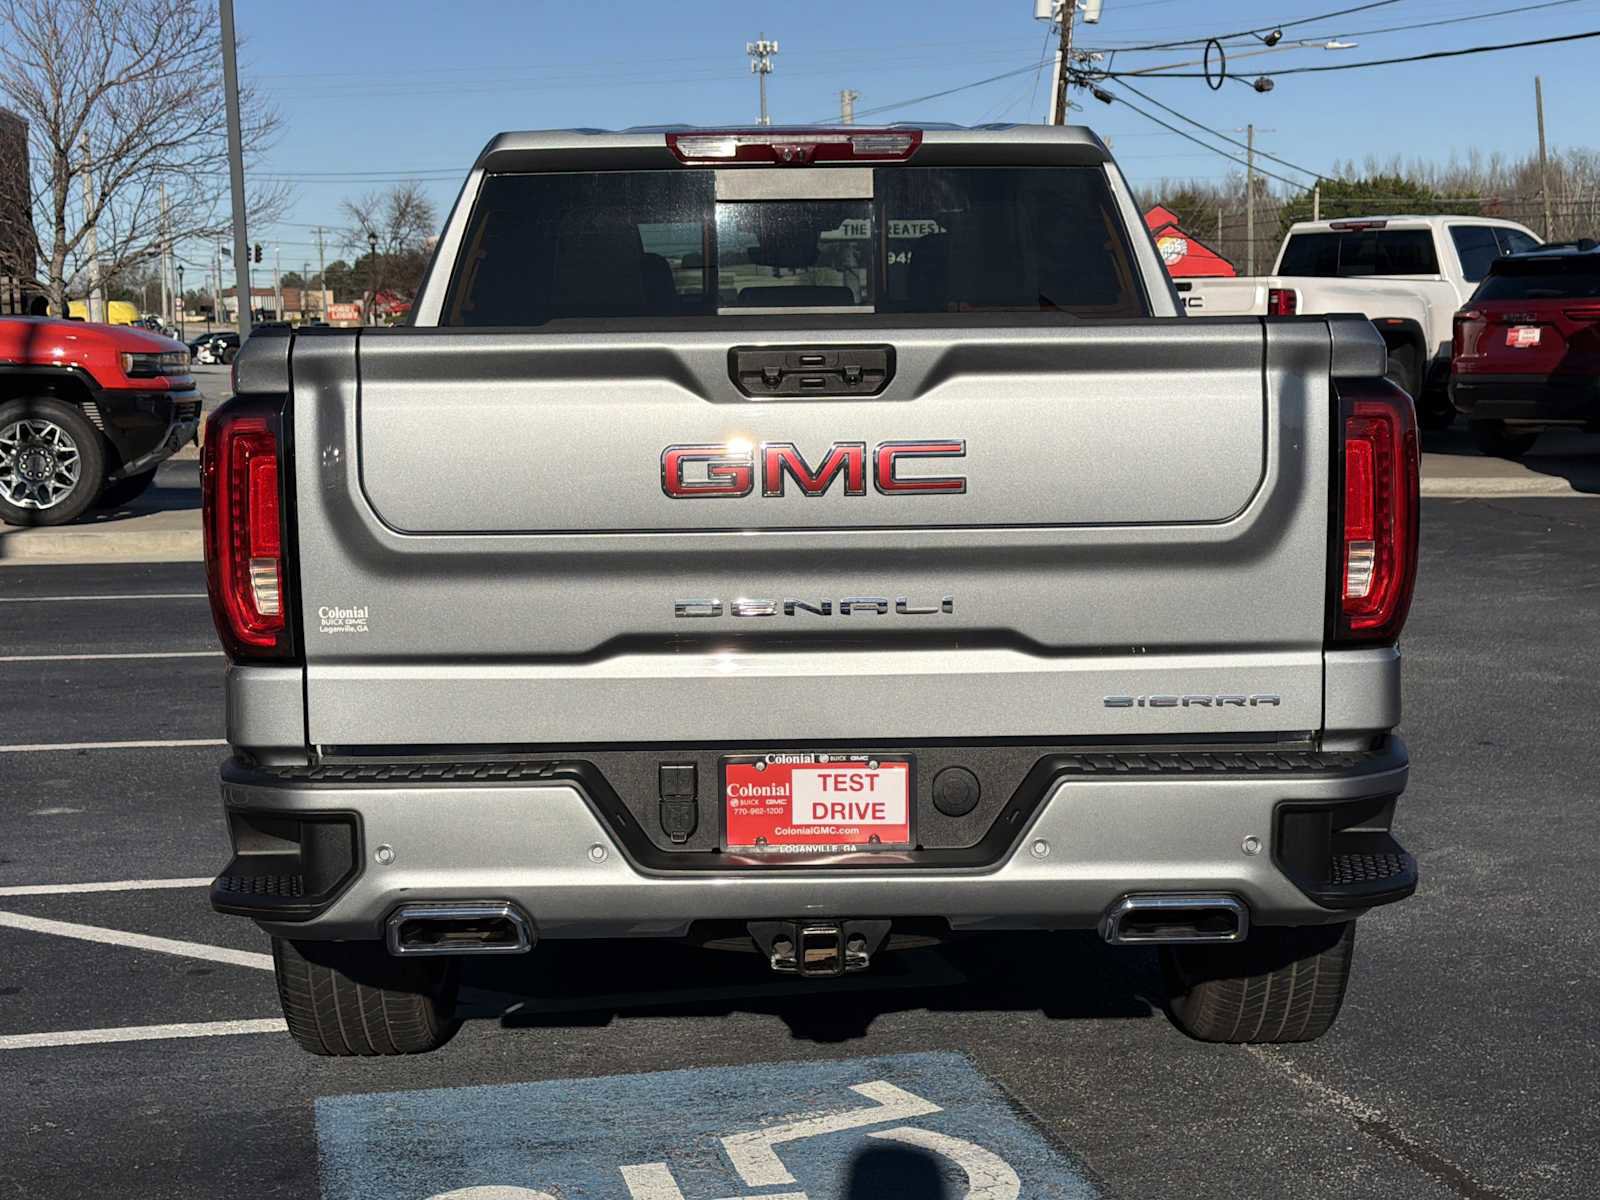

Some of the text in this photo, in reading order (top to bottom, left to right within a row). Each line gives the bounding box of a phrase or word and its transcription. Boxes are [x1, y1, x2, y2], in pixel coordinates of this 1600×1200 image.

[843, 223, 867, 236] THE
[660, 439, 967, 499] GMC
[319, 606, 368, 618] Colonial
[674, 595, 953, 618] DENALI
[1103, 694, 1281, 708] SIERRA
[765, 753, 815, 765] Colonial
[817, 773, 880, 792] TEST
[726, 783, 790, 798] Colonial
[812, 802, 886, 820] DRIVE
[775, 826, 860, 836] ColonialGMC.com
